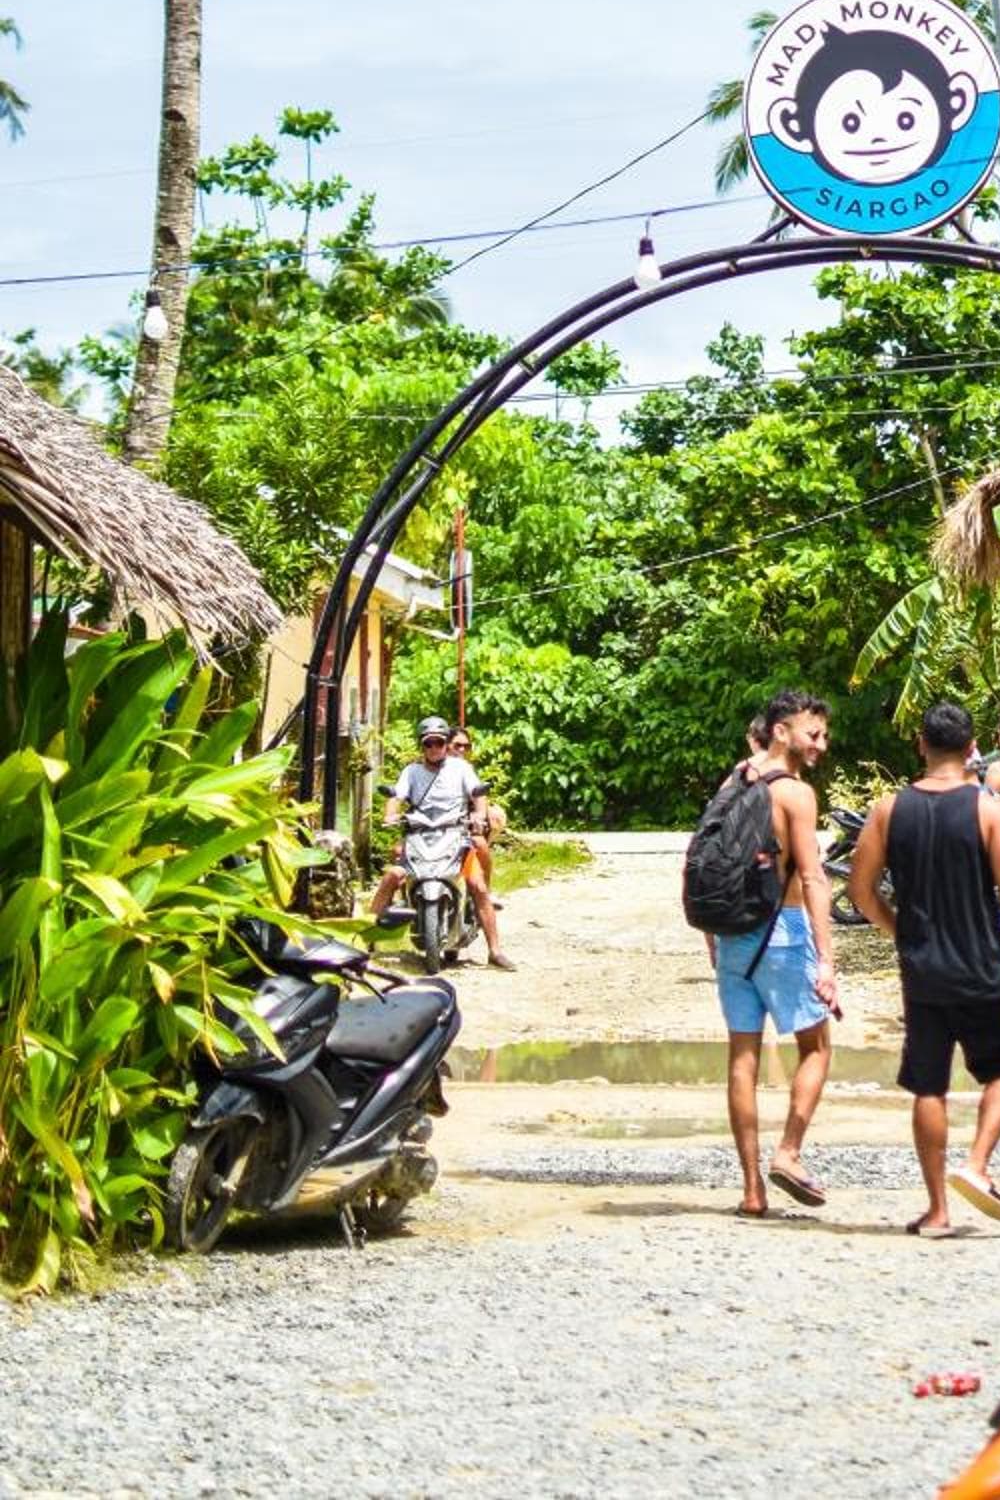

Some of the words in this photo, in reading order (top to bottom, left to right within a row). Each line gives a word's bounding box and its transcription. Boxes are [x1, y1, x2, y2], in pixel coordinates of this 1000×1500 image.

[767, 23, 816, 87] MAD
[840, 1, 968, 56] MONKEY
[816, 179, 950, 219] SIARGAO
